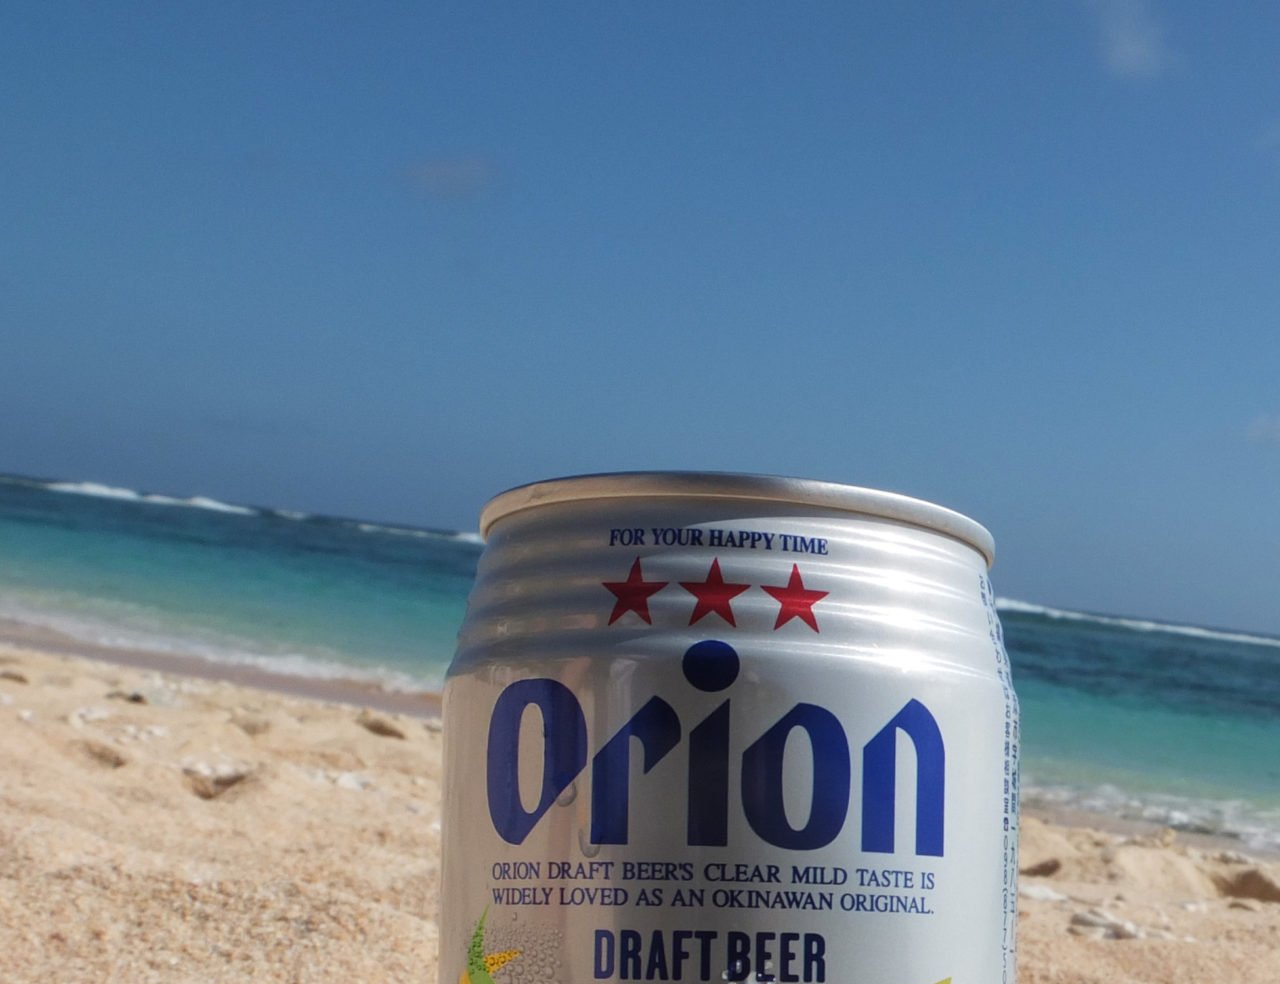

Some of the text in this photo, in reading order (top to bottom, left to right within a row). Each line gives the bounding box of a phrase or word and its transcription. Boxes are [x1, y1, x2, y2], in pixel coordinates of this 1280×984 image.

[609, 528, 828, 555] FOR YOUR HAPPY TIME
[492, 862, 935, 889] ORION DRAFT BEER'S CLEAR MILD TASTE IS
[492, 887, 935, 914] WIDELY LOVED AS AN OKINAWAN ORIGINAL.
[593, 929, 826, 983] DRAFT BEER
